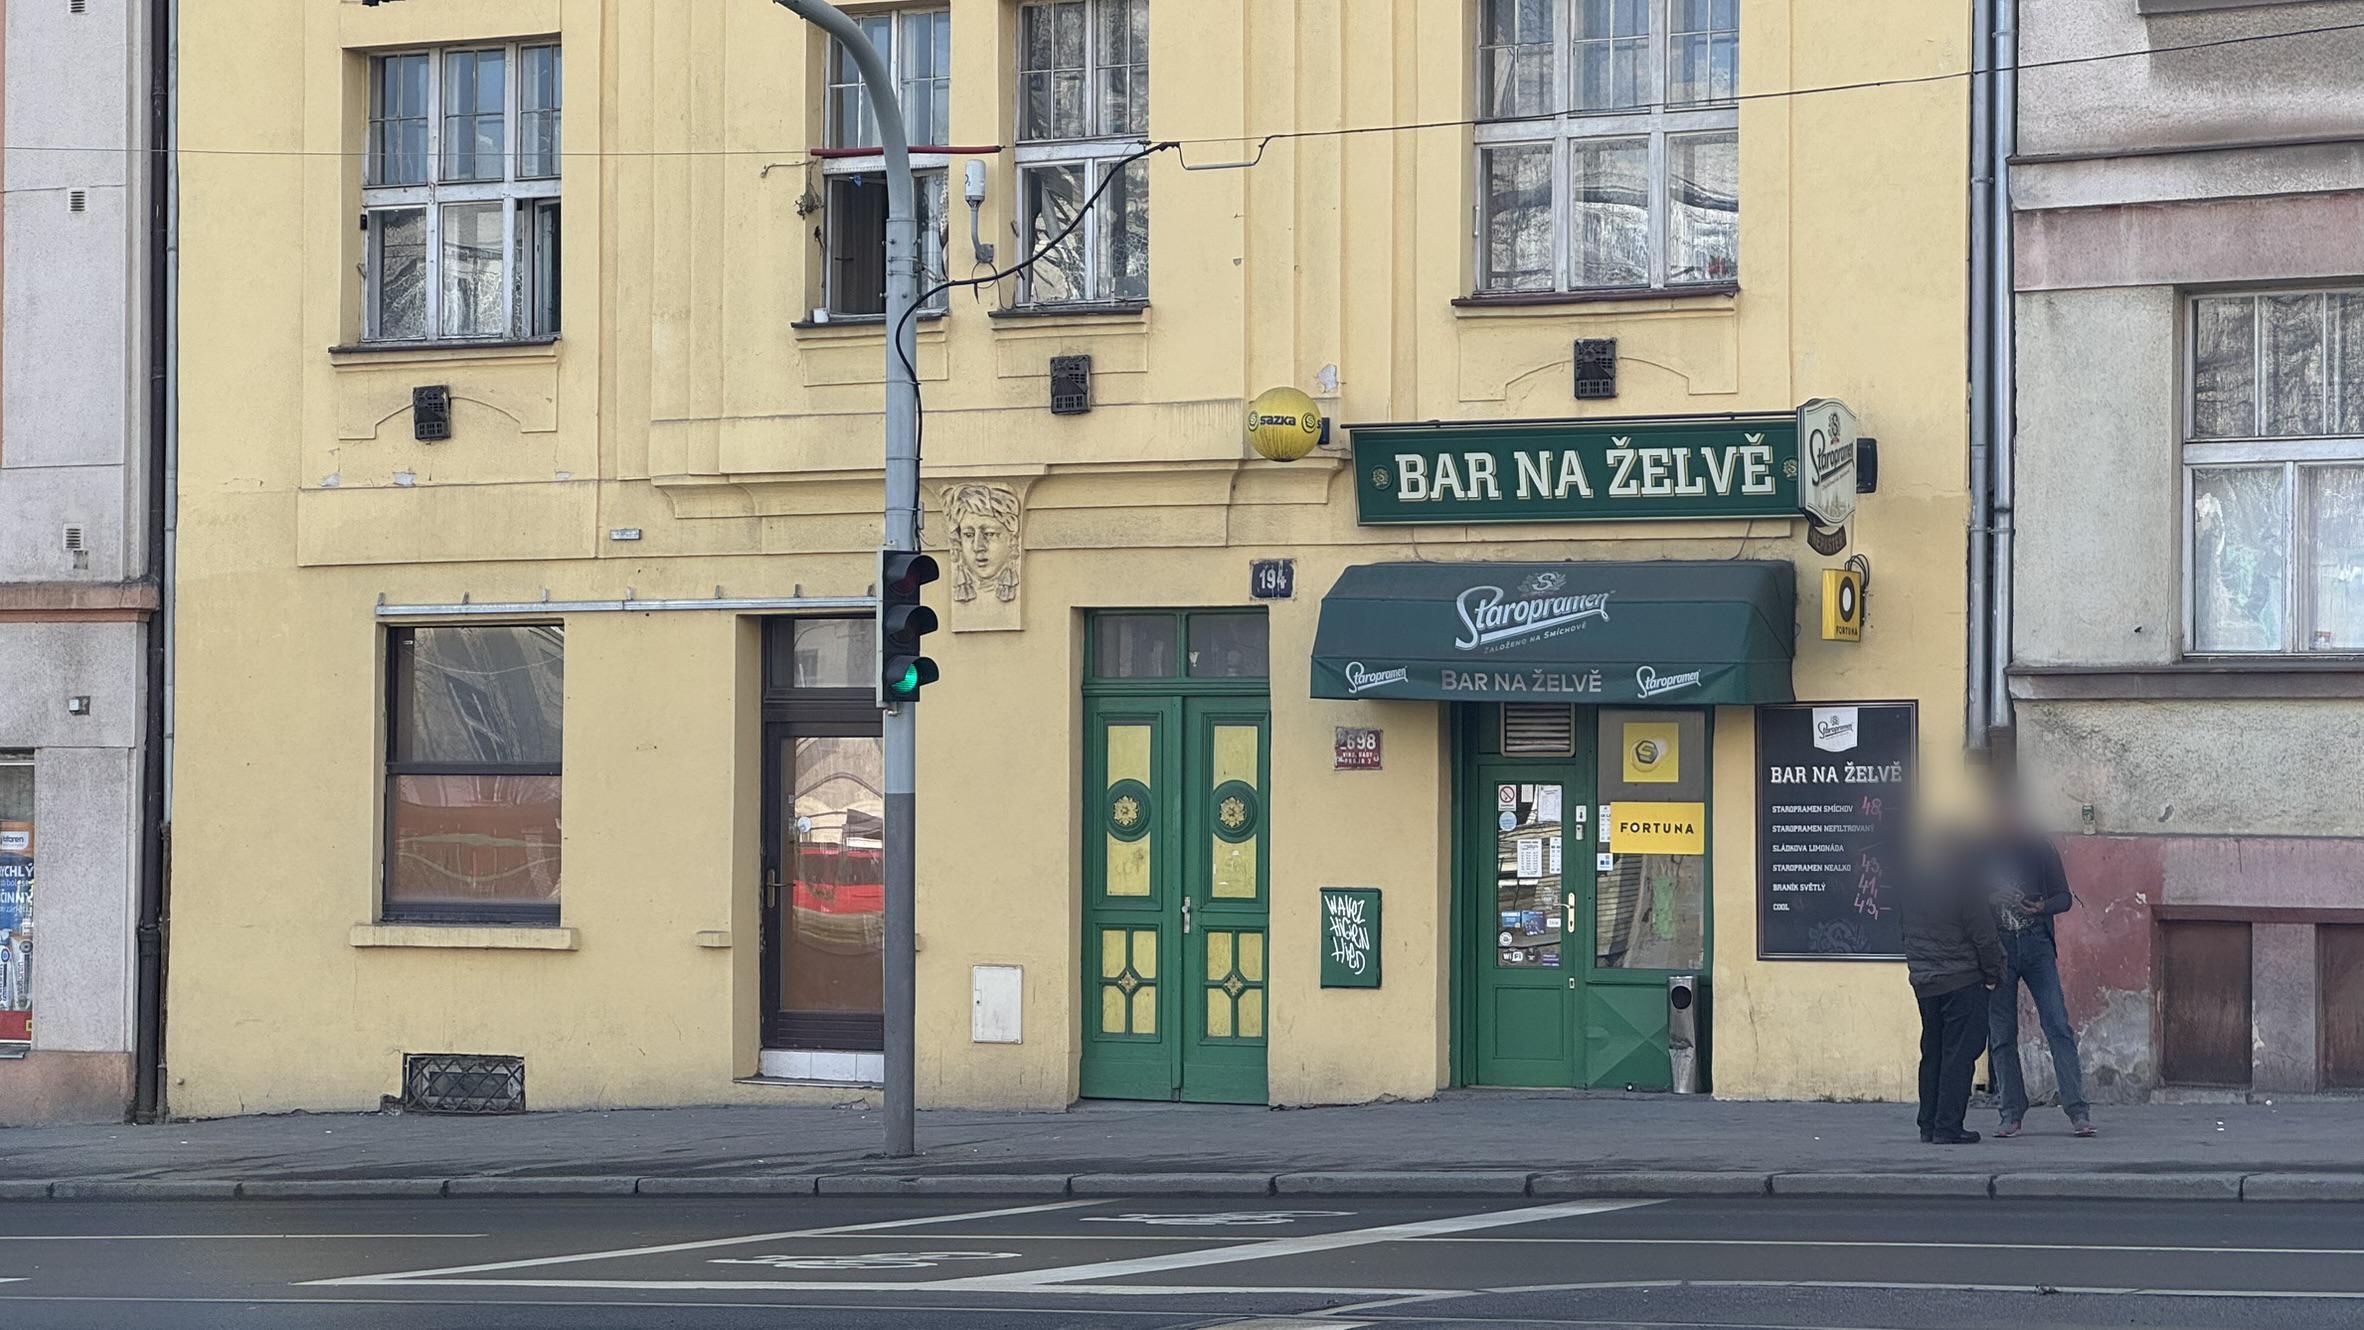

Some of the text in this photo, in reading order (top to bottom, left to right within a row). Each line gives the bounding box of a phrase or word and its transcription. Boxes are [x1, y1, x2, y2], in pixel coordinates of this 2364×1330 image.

[1259, 415, 1297, 427] sazka
[1394, 433, 1777, 502] BAR NA ŽELVĚ
[1259, 568, 1287, 590] 194
[1455, 586, 1611, 650] Staropramen
[1835, 625, 1858, 636] FORTUNA
[1345, 661, 1408, 693] Staropramen
[1441, 669, 1602, 692] BAR NA ŽELVĚ
[1636, 666, 1701, 698] Staropramen
[1770, 761, 1902, 784] BAR NA ŽELVĚ
[1771, 805, 1822, 813] STAROPRAMEN
[1823, 804, 1854, 813] SMÍCHOV
[1620, 822, 1694, 834] FORTUNA
[1771, 825, 1822, 833] STAROPRAMEN
[1772, 843, 1845, 852] SLÁDKOVA LIMONÁDA
[1772, 864, 1823, 872] STAROPRAMEN
[1823, 864, 1852, 872] NEALKO
[1772, 882, 1799, 892] BRANÍK
[1800, 882, 1826, 892] SVĚTLÝ
[1772, 903, 1790, 911] COOL
